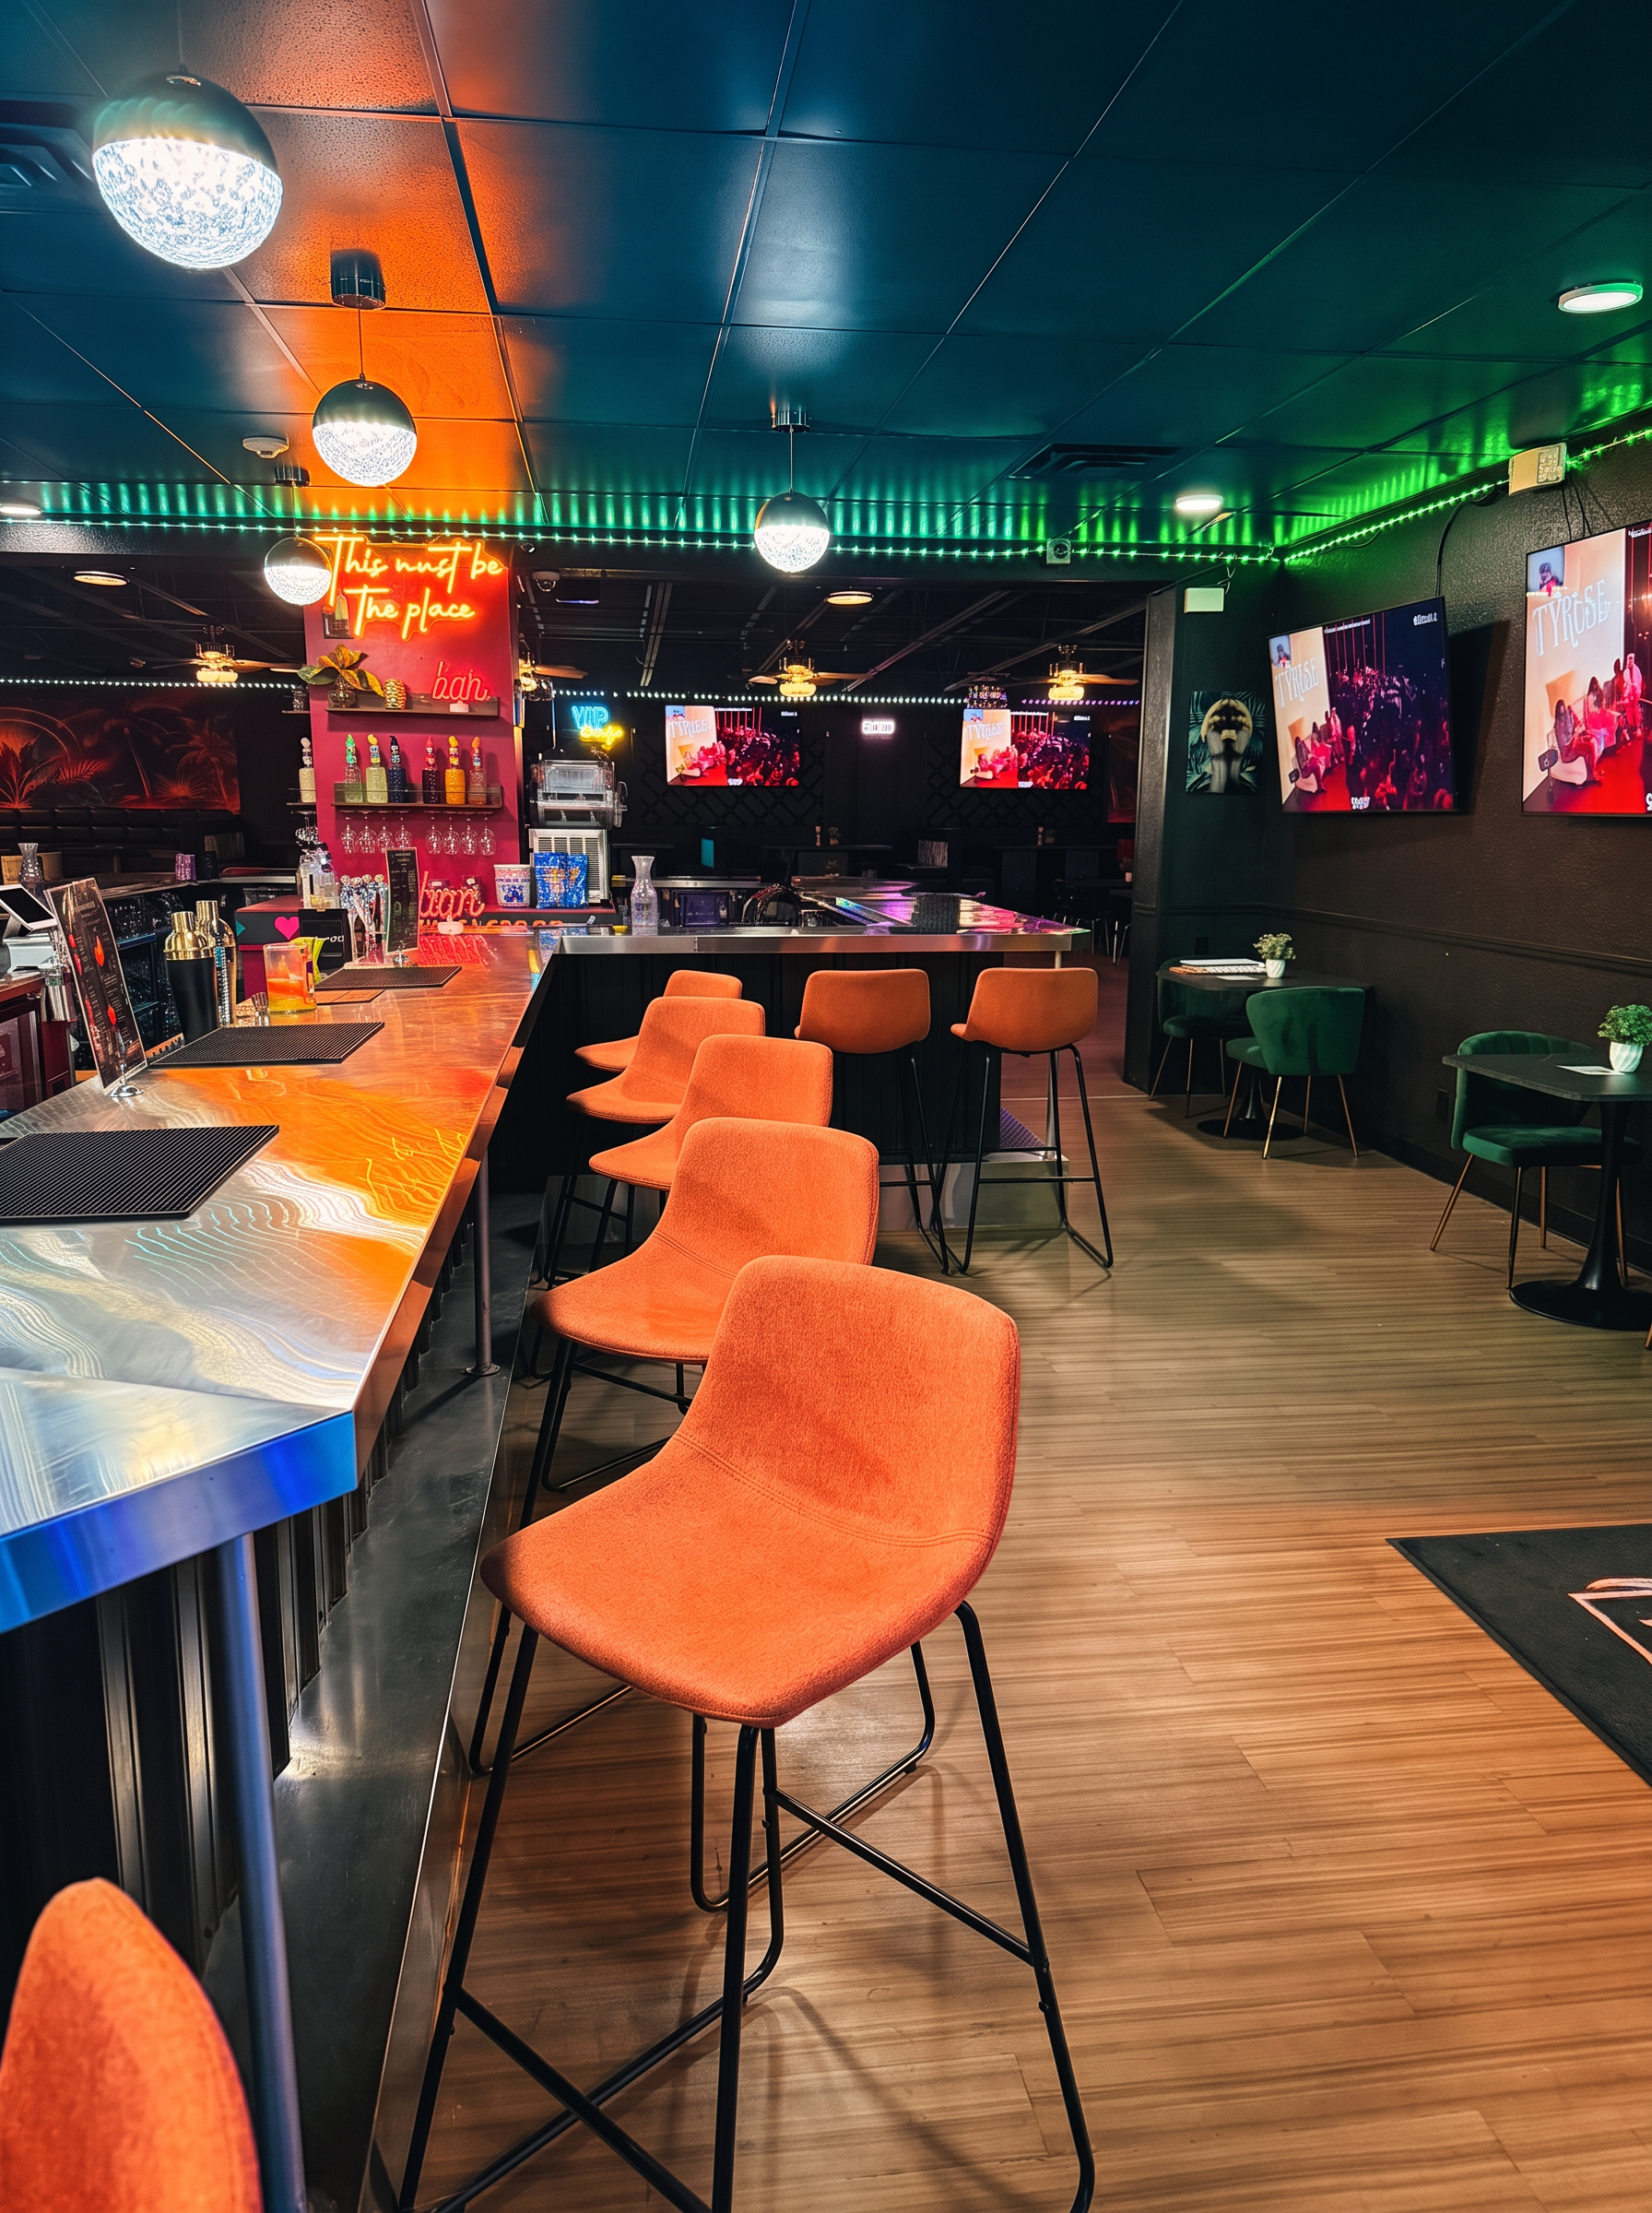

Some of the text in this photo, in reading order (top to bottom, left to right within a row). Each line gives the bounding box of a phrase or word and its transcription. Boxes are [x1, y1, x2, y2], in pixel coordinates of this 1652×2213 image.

[313, 535, 389, 608] This
[469, 541, 503, 580] be
[401, 586, 476, 641] place
[571, 705, 609, 729] VIP
